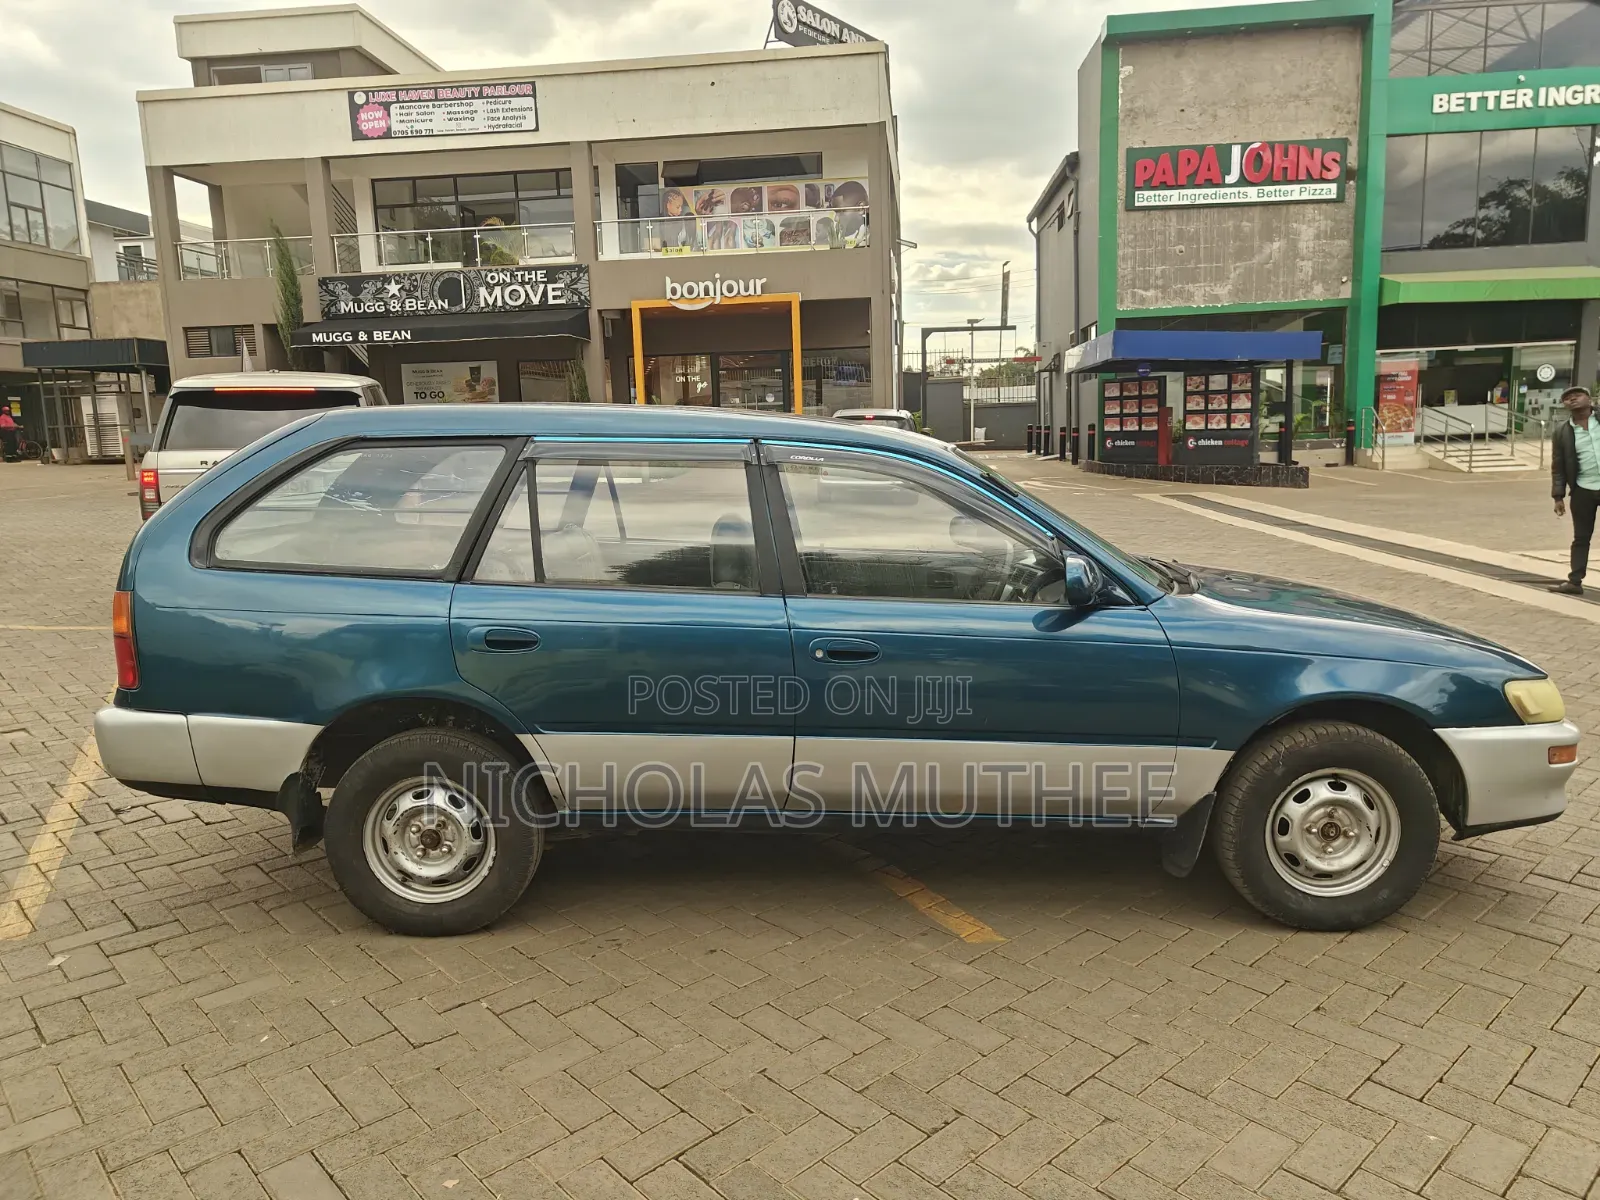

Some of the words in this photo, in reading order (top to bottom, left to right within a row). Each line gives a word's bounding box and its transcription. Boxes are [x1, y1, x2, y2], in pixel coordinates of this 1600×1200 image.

[797, 5, 840, 38] SALON
[798, 25, 830, 43] PEDICURE
[369, 91, 397, 102] LUXE
[398, 89, 436, 101] HAVEN
[437, 87, 480, 99] BEAUTY
[482, 84, 533, 97] PARLOUR
[1432, 88, 1534, 114] BETTER
[446, 109, 478, 117] Massage
[501, 105, 534, 113] Extensions
[361, 111, 383, 121] NOW
[361, 120, 386, 131] OPEN
[487, 122, 523, 131] Hydrafacial
[1134, 145, 1222, 188] PAPA
[1224, 141, 1341, 184] JOHNS
[1136, 192, 1175, 203] Better
[1178, 189, 1252, 201] Ingredients.
[1256, 187, 1295, 198] Better
[1299, 185, 1336, 197] Pizza.
[487, 272, 511, 284] ON
[514, 270, 548, 282] THE
[480, 283, 567, 308] MOVE
[665, 273, 767, 305] bonjour
[389, 299, 402, 312] &
[312, 332, 353, 343] MUGG
[358, 331, 368, 341] &
[373, 330, 411, 341] BEAN
[675, 375, 686, 383] ON
[414, 391, 427, 400] TO
[429, 391, 445, 399] GO
